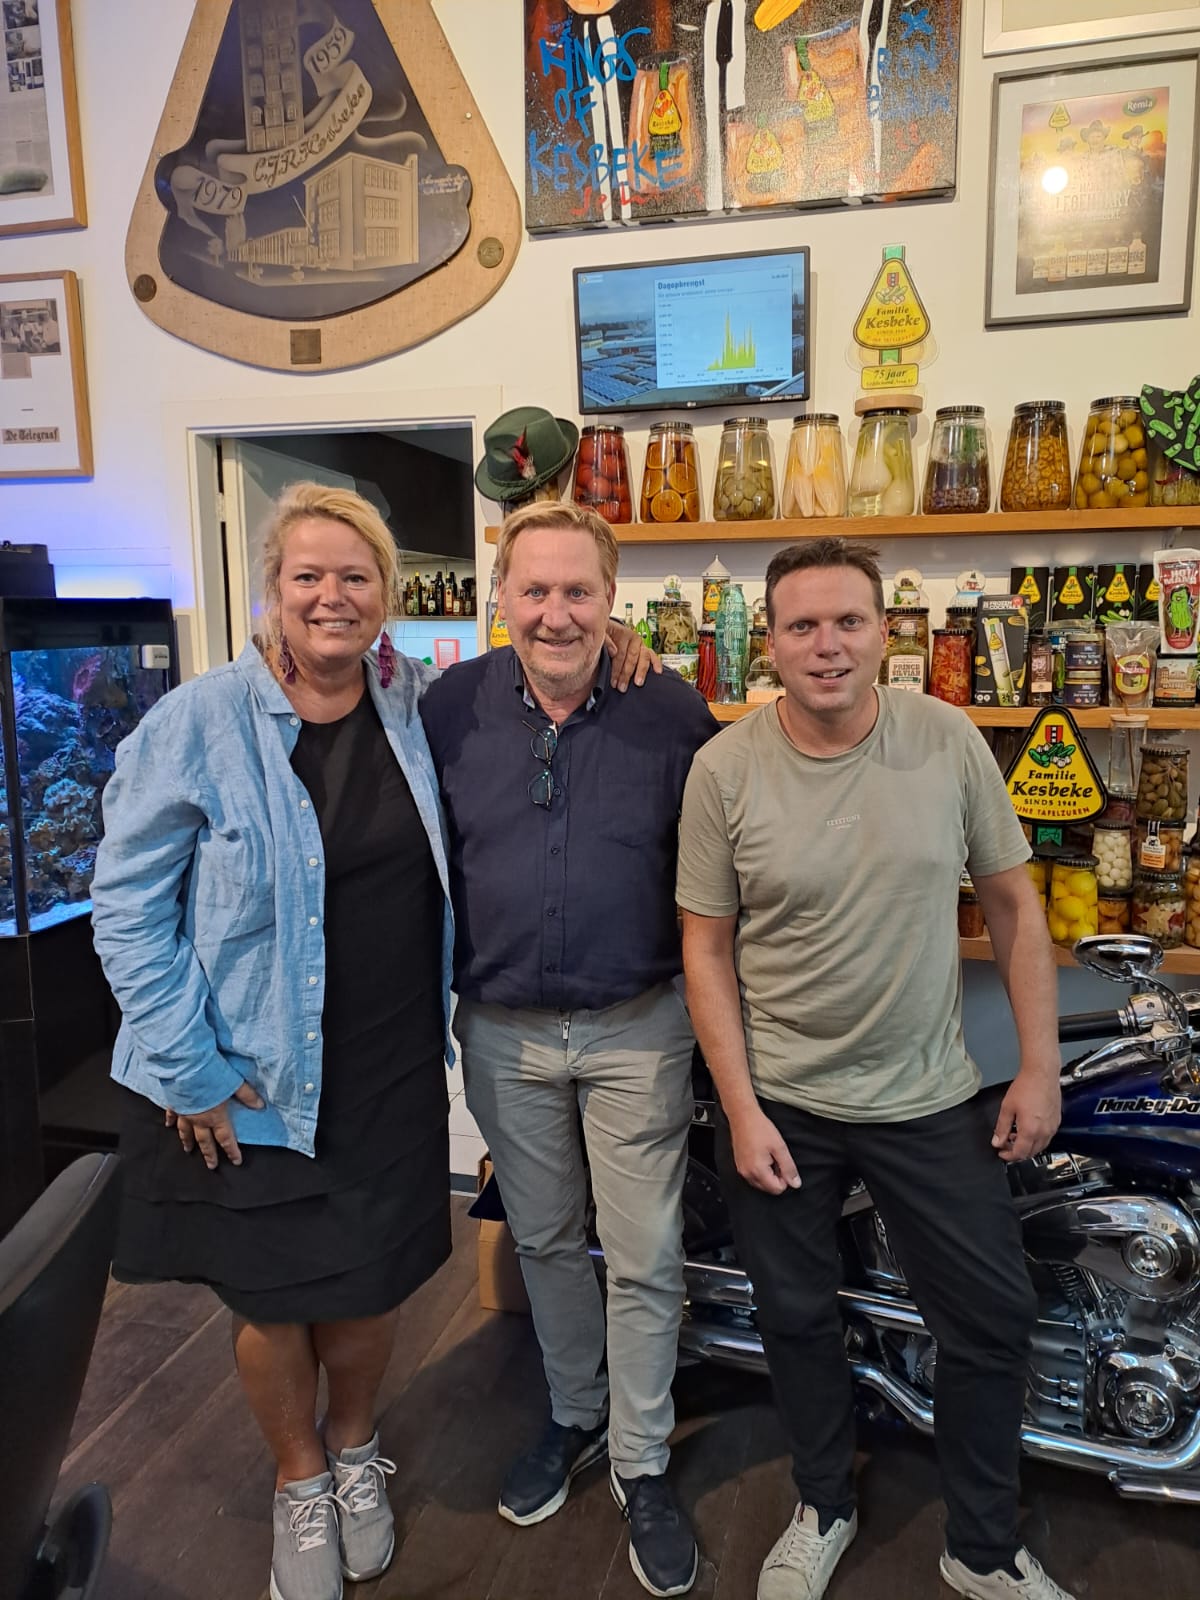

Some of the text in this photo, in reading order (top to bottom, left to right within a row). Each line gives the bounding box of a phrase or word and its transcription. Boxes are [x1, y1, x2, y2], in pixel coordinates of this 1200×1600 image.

[309, 27, 347, 73] 1959
[539, 24, 651, 90] KINGS
[554, 85, 598, 138] OF
[1127, 99, 1153, 111] Remia
[528, 130, 687, 197] KESBEKE
[193, 175, 243, 210] 1979
[657, 278, 705, 291] Dagopbrengst
[876, 306, 910, 317] Familie
[865, 315, 921, 330] Kesbeke
[873, 368, 907, 381] 75 jaar
[5, 427, 59, 442] De Telegraaf
[893, 663, 921, 671] PRINCE
[1028, 769, 1076, 781] Familie
[1011, 781, 1094, 798] Kesbeke
[1024, 798, 1054, 806] SINDS
[1037, 806, 1090, 817] TAFELZUREN
